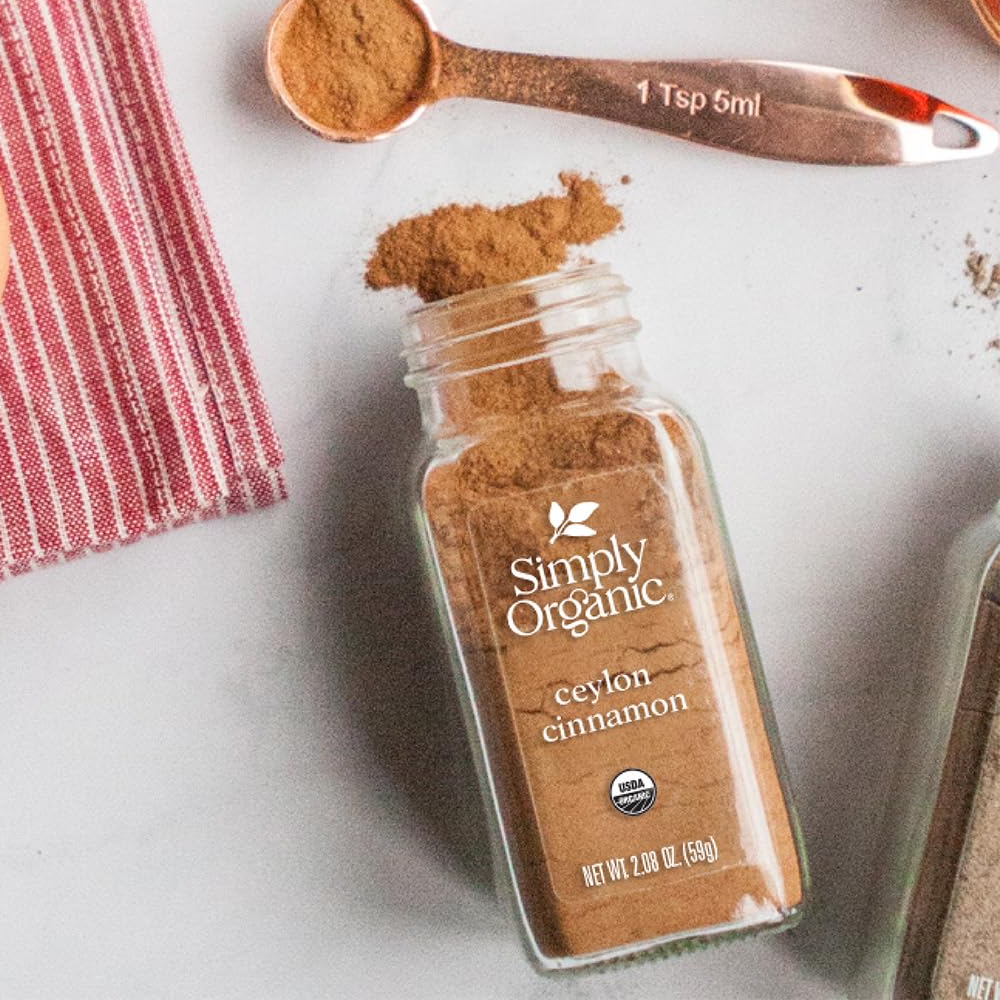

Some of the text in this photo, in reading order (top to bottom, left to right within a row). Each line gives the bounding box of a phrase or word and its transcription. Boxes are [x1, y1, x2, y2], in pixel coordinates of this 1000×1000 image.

[637, 80, 761, 117] 1 Tsp 5ml
[510, 534, 648, 597] Simply
[554, 668, 652, 706] ceylon
[542, 692, 688, 743] cinnamon
[618, 778, 645, 793] USDA
[582, 835, 718, 887] NET WT. 2.08 OZ. (59g)
